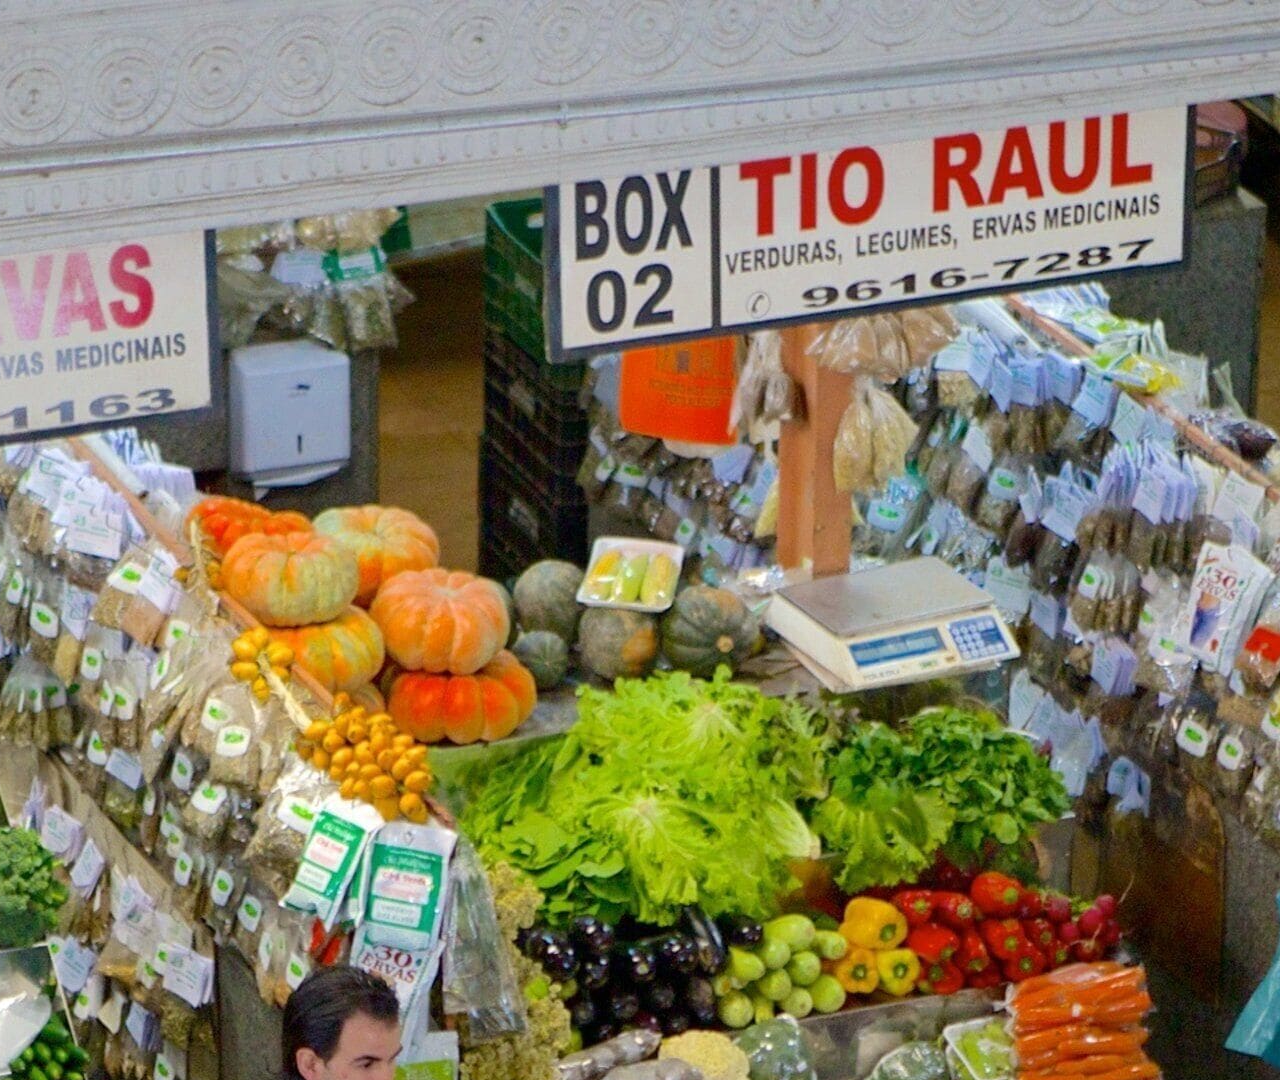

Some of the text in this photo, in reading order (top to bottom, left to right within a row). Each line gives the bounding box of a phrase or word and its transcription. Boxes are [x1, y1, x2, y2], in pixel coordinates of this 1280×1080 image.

[740, 112, 1153, 237] TIO RAUL
[575, 170, 693, 262] BOX
[726, 194, 1161, 275] VERDURAS, LEGUMES, ERVAS MEDICINAIS
[586, 263, 674, 333] 02
[802, 238, 1154, 308] 9616-7287
[56, 333, 187, 372] MEDICINAIS
[360, 951, 417, 984] ERVAS
[373, 944, 413, 968] 30
